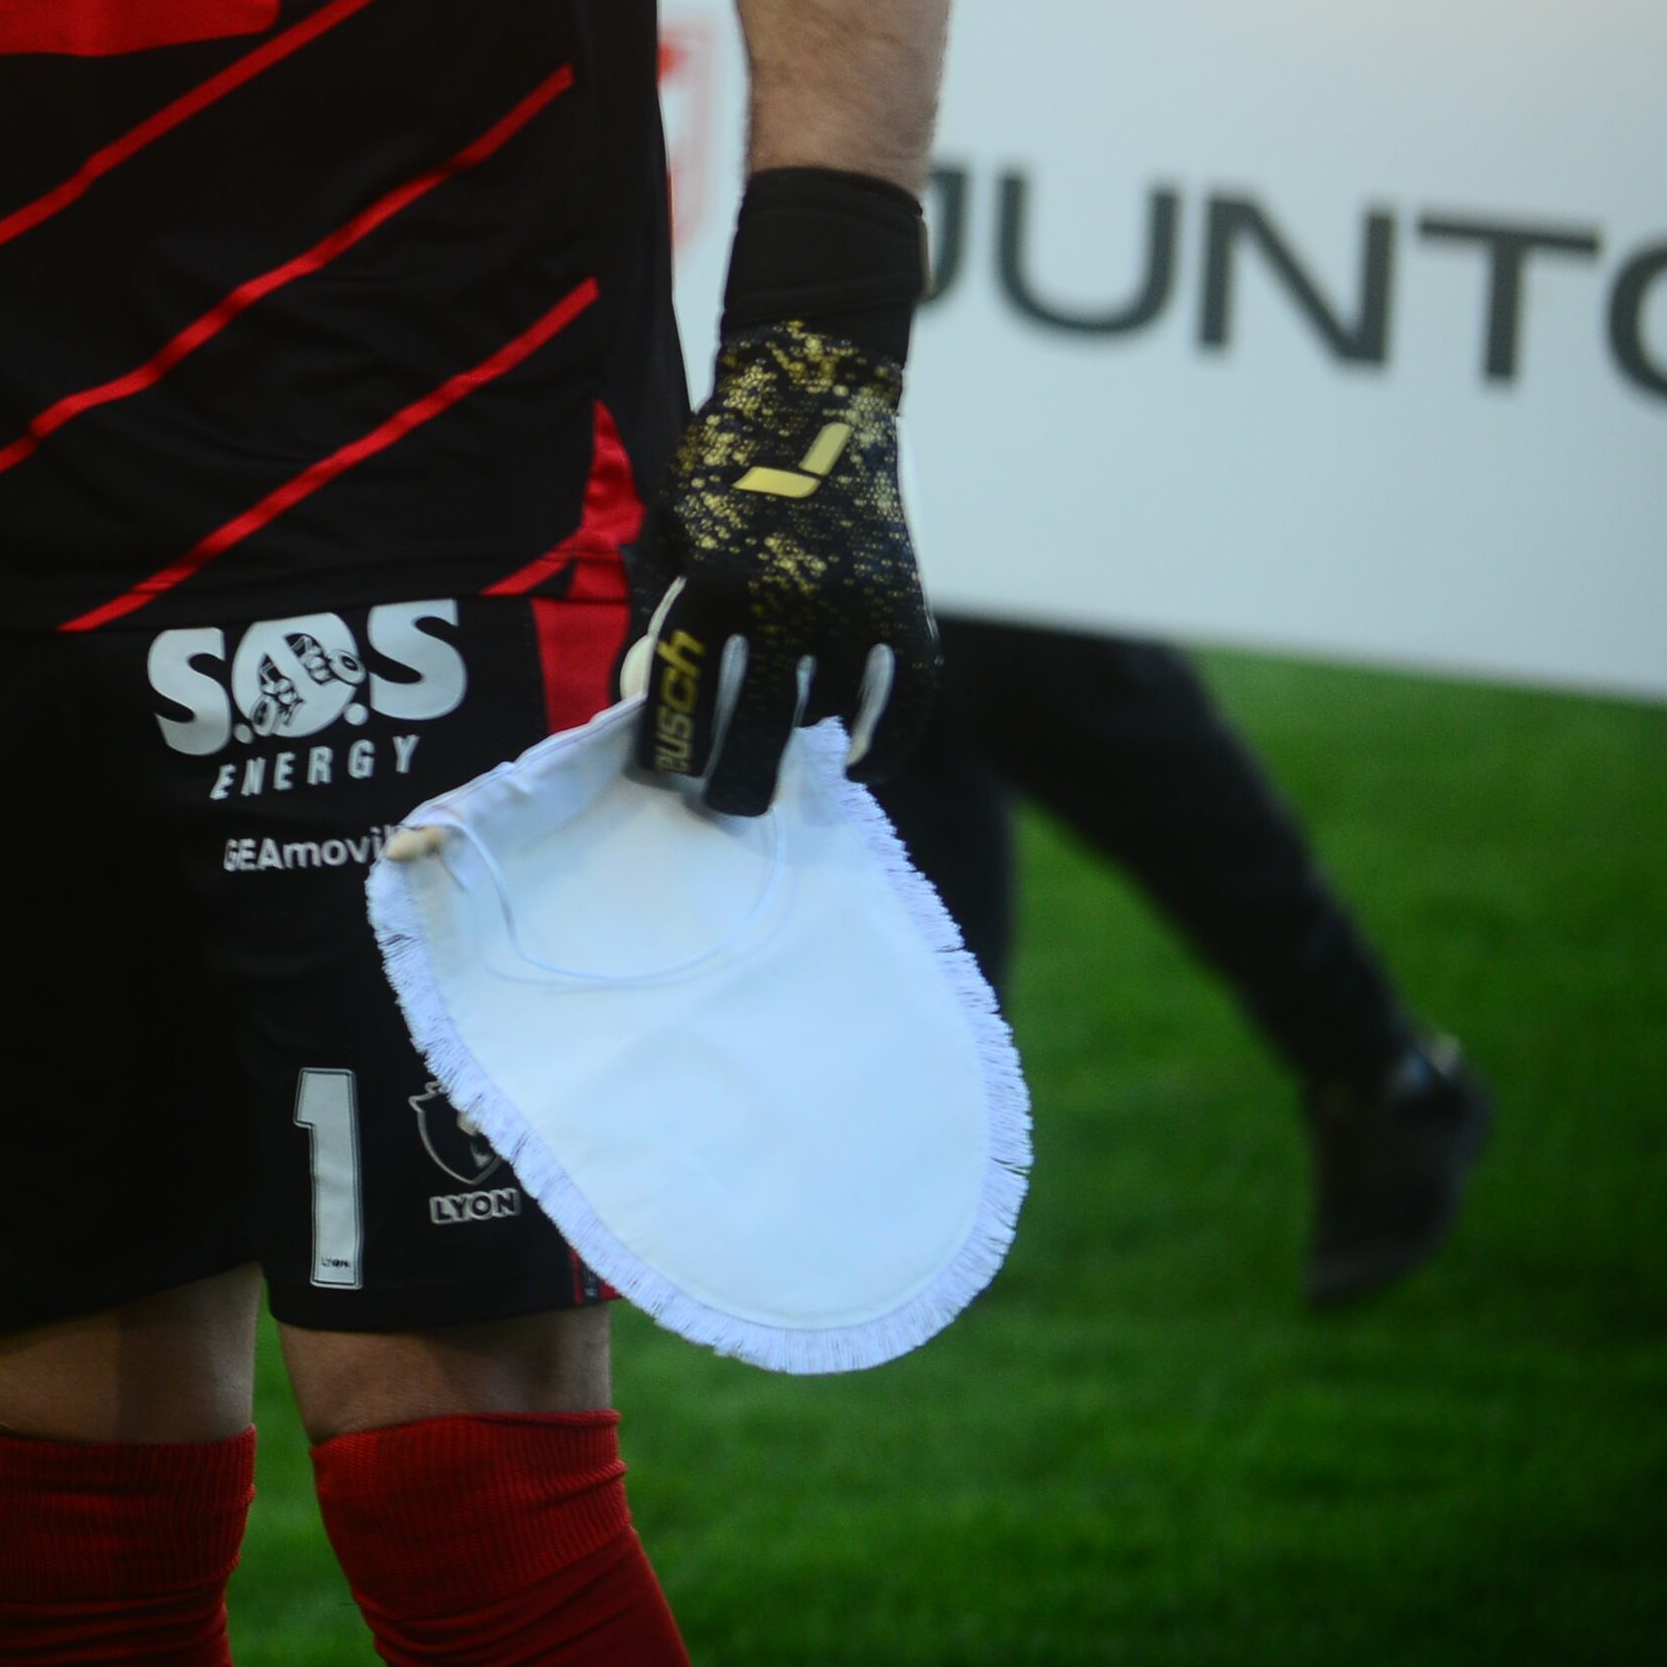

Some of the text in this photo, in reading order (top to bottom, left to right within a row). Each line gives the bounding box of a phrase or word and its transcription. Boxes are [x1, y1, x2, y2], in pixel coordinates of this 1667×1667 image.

[914, 162, 1667, 408] JUNT
[209, 734, 421, 801] ENERGY
[293, 1067, 364, 1291] 1
[429, 1187, 522, 1224] LYON
